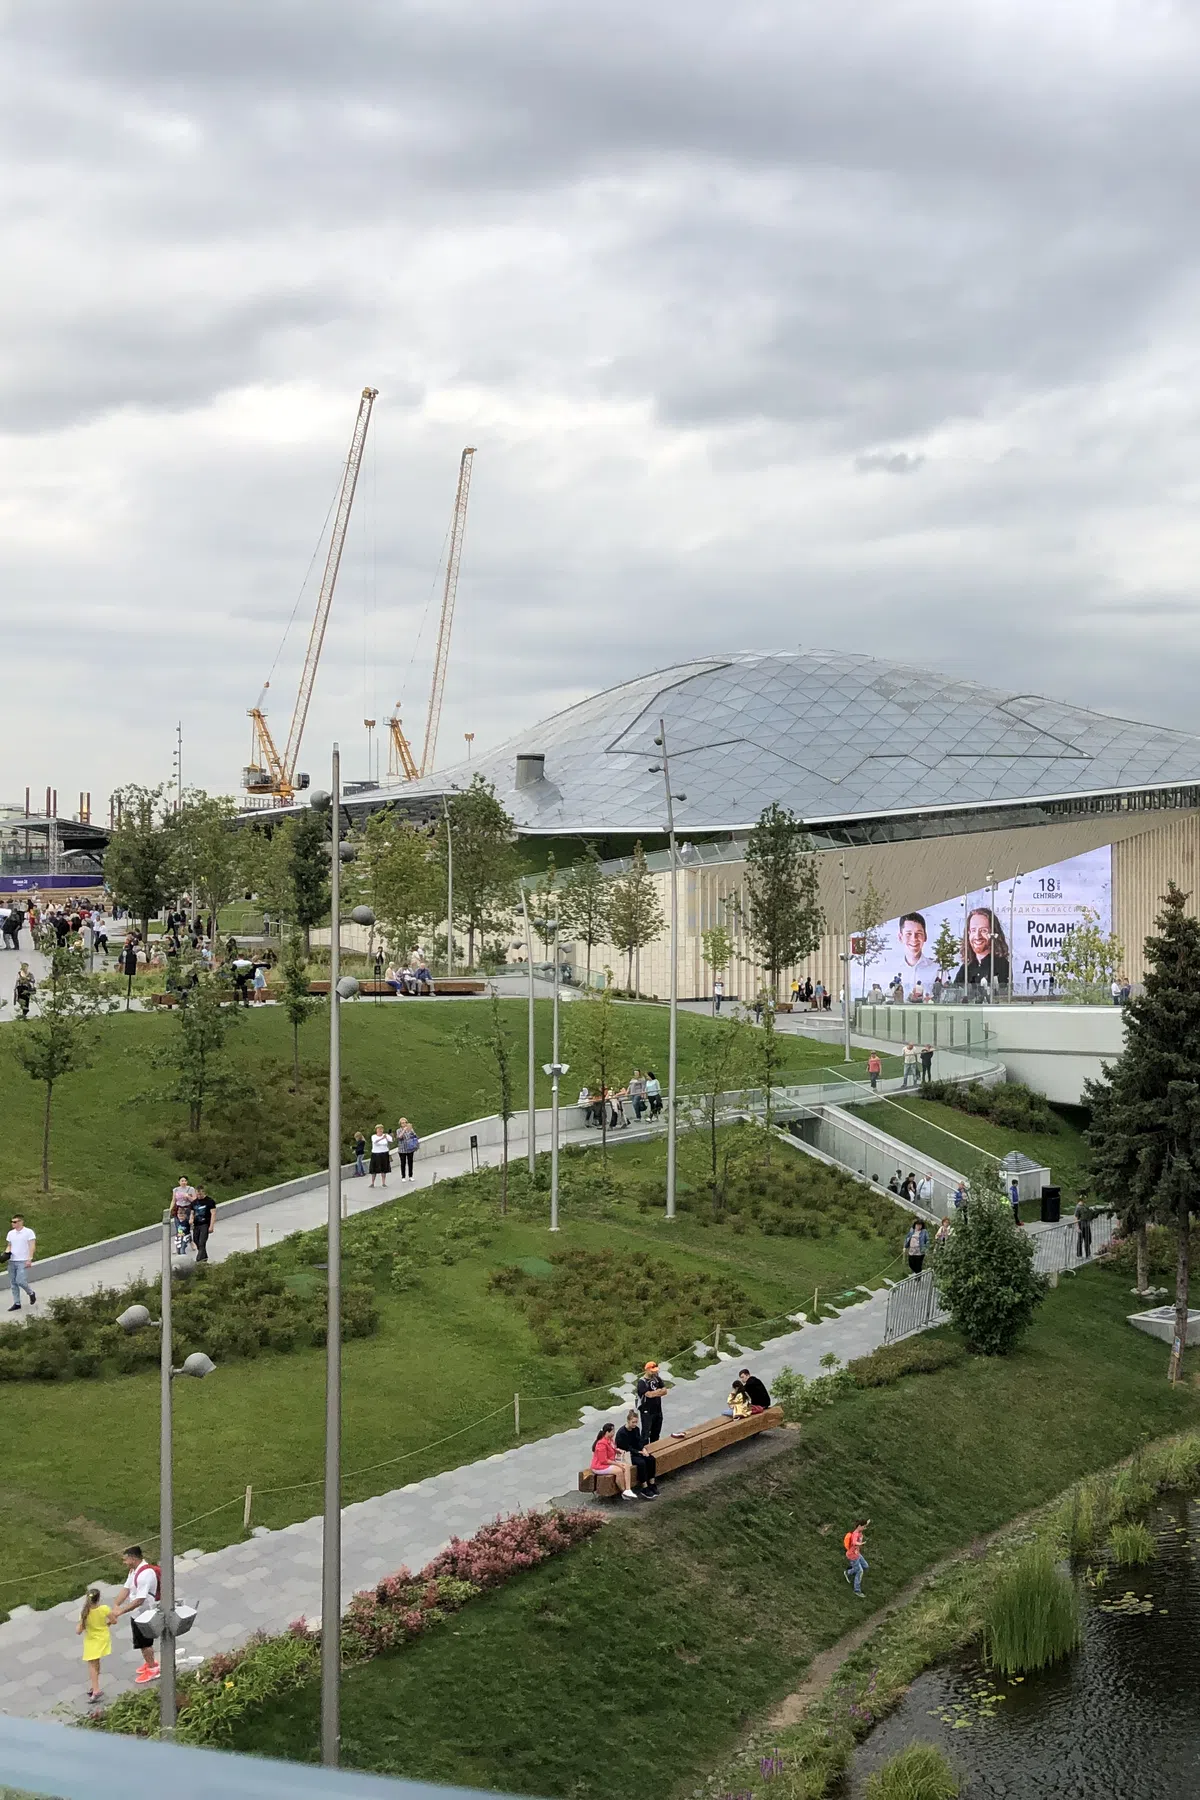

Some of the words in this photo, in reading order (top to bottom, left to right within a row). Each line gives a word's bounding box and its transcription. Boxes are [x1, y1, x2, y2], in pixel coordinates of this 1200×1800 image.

[1038, 878, 1056, 892] 18
[1027, 920, 1075, 934] Роман
[1030, 934, 1069, 948] Мин
[1022, 960, 1077, 976] Андре
